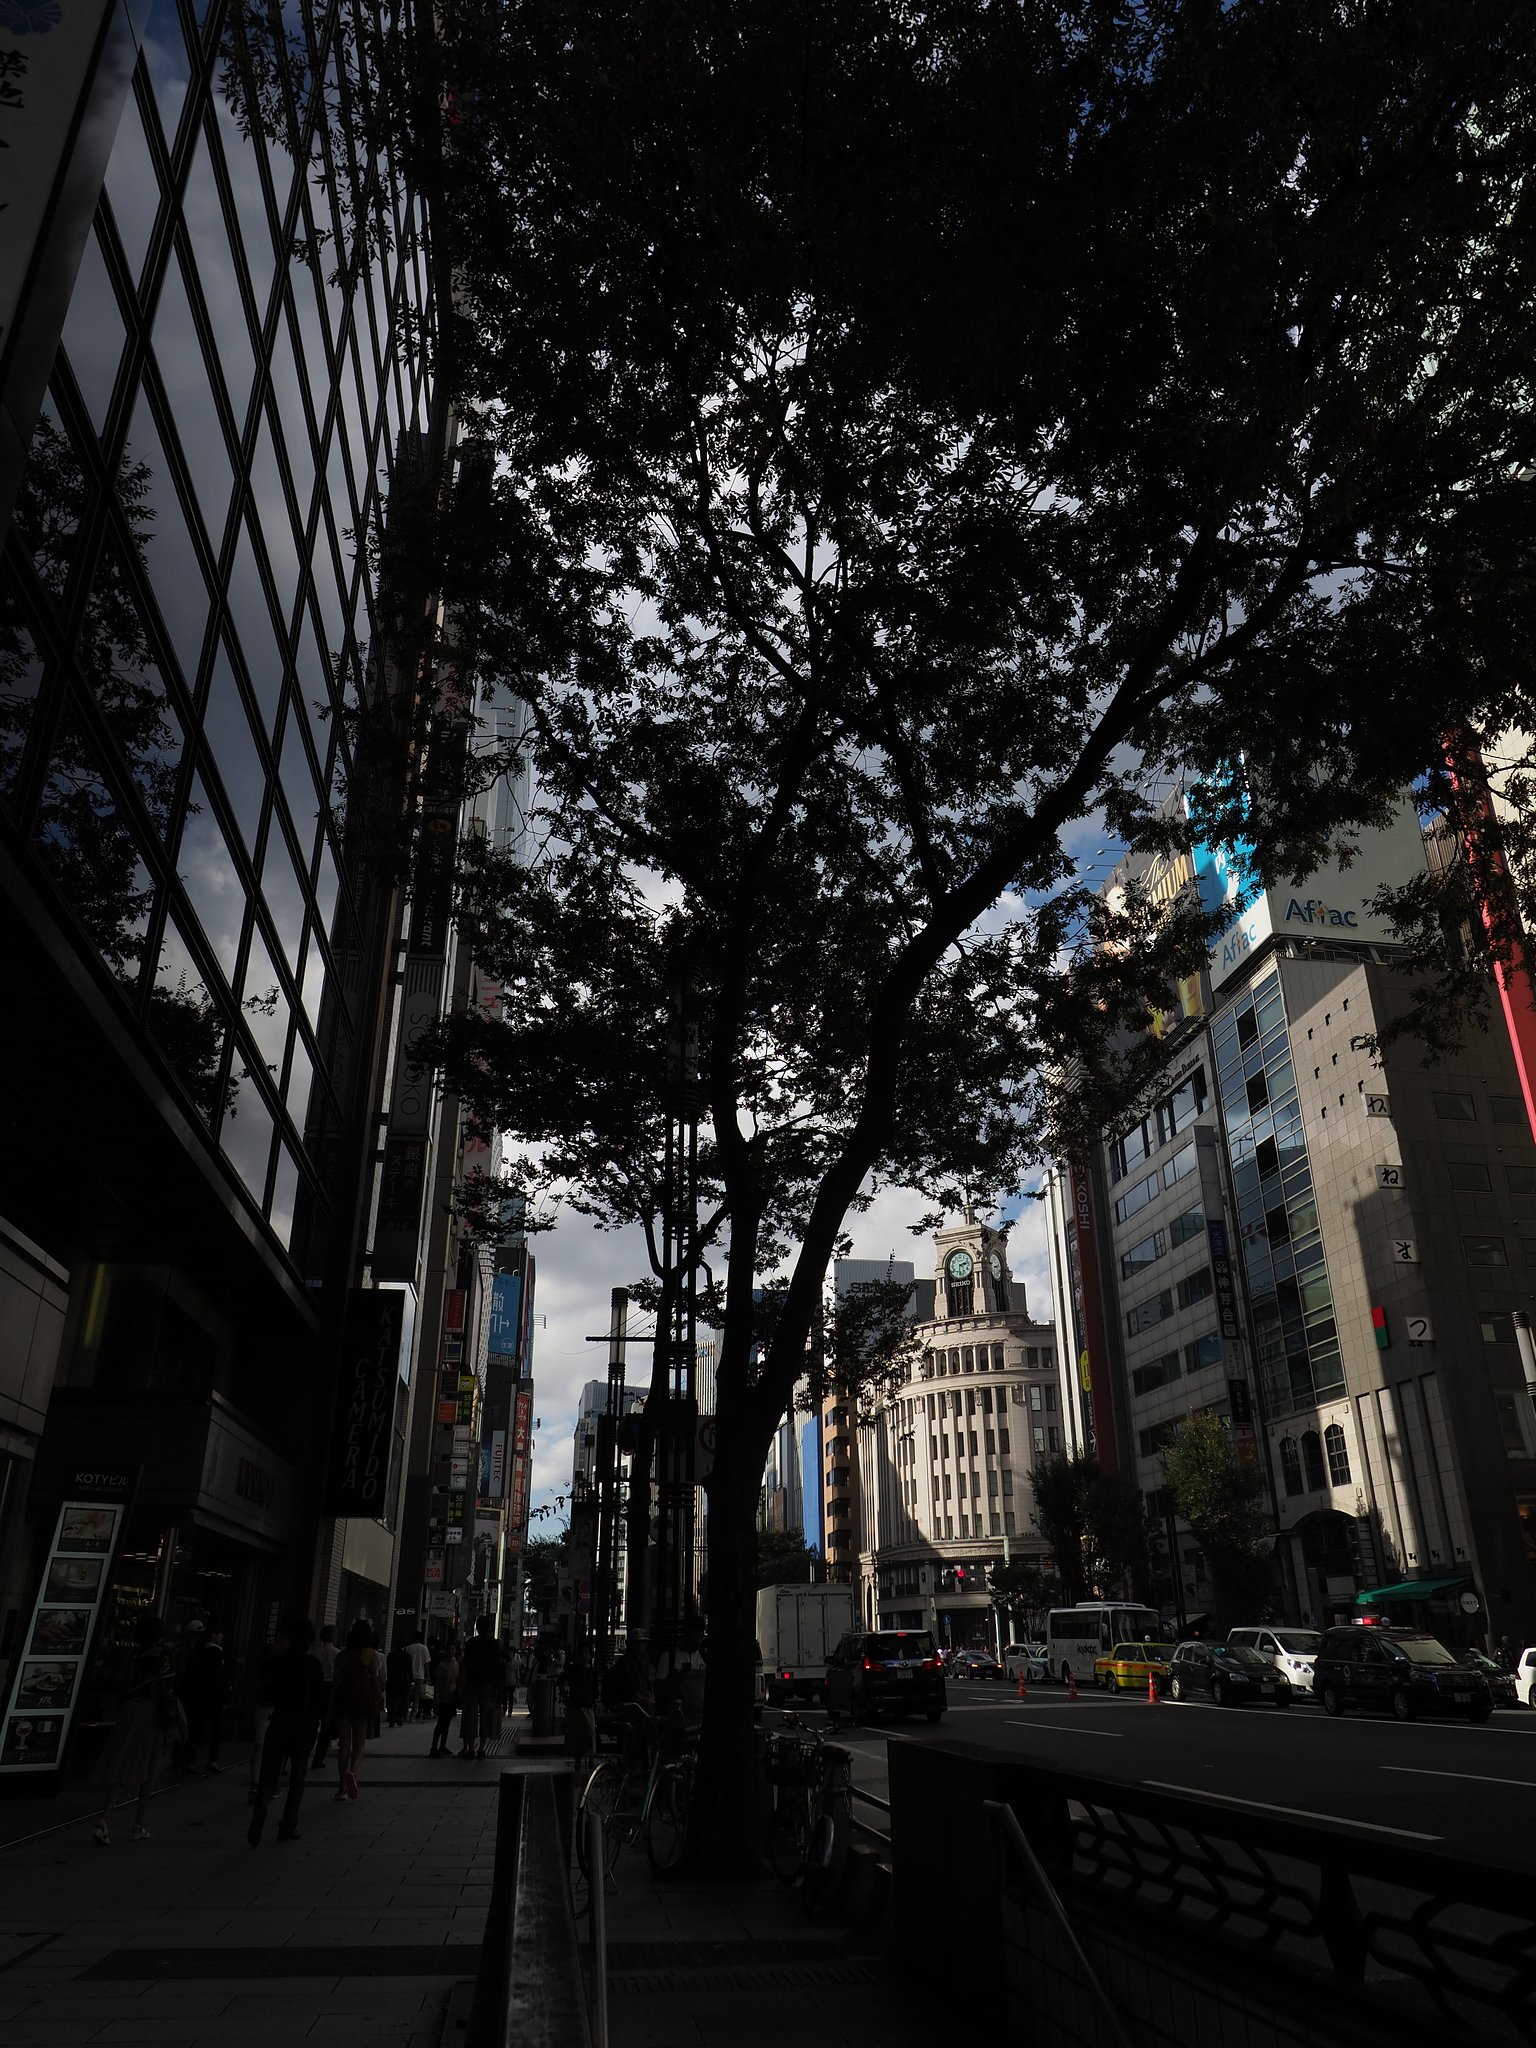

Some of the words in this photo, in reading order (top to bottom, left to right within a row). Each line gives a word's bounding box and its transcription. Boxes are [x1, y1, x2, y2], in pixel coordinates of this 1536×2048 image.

[1285, 898, 1359, 928] Aflac
[1222, 922, 1257, 971] Aflac
[951, 1280, 971, 1288] SEIKO
[343, 1358, 371, 1491] CAMERA
[361, 1305, 396, 1501] KATSUMIDO
[493, 1444, 502, 1482] FUJITEC
